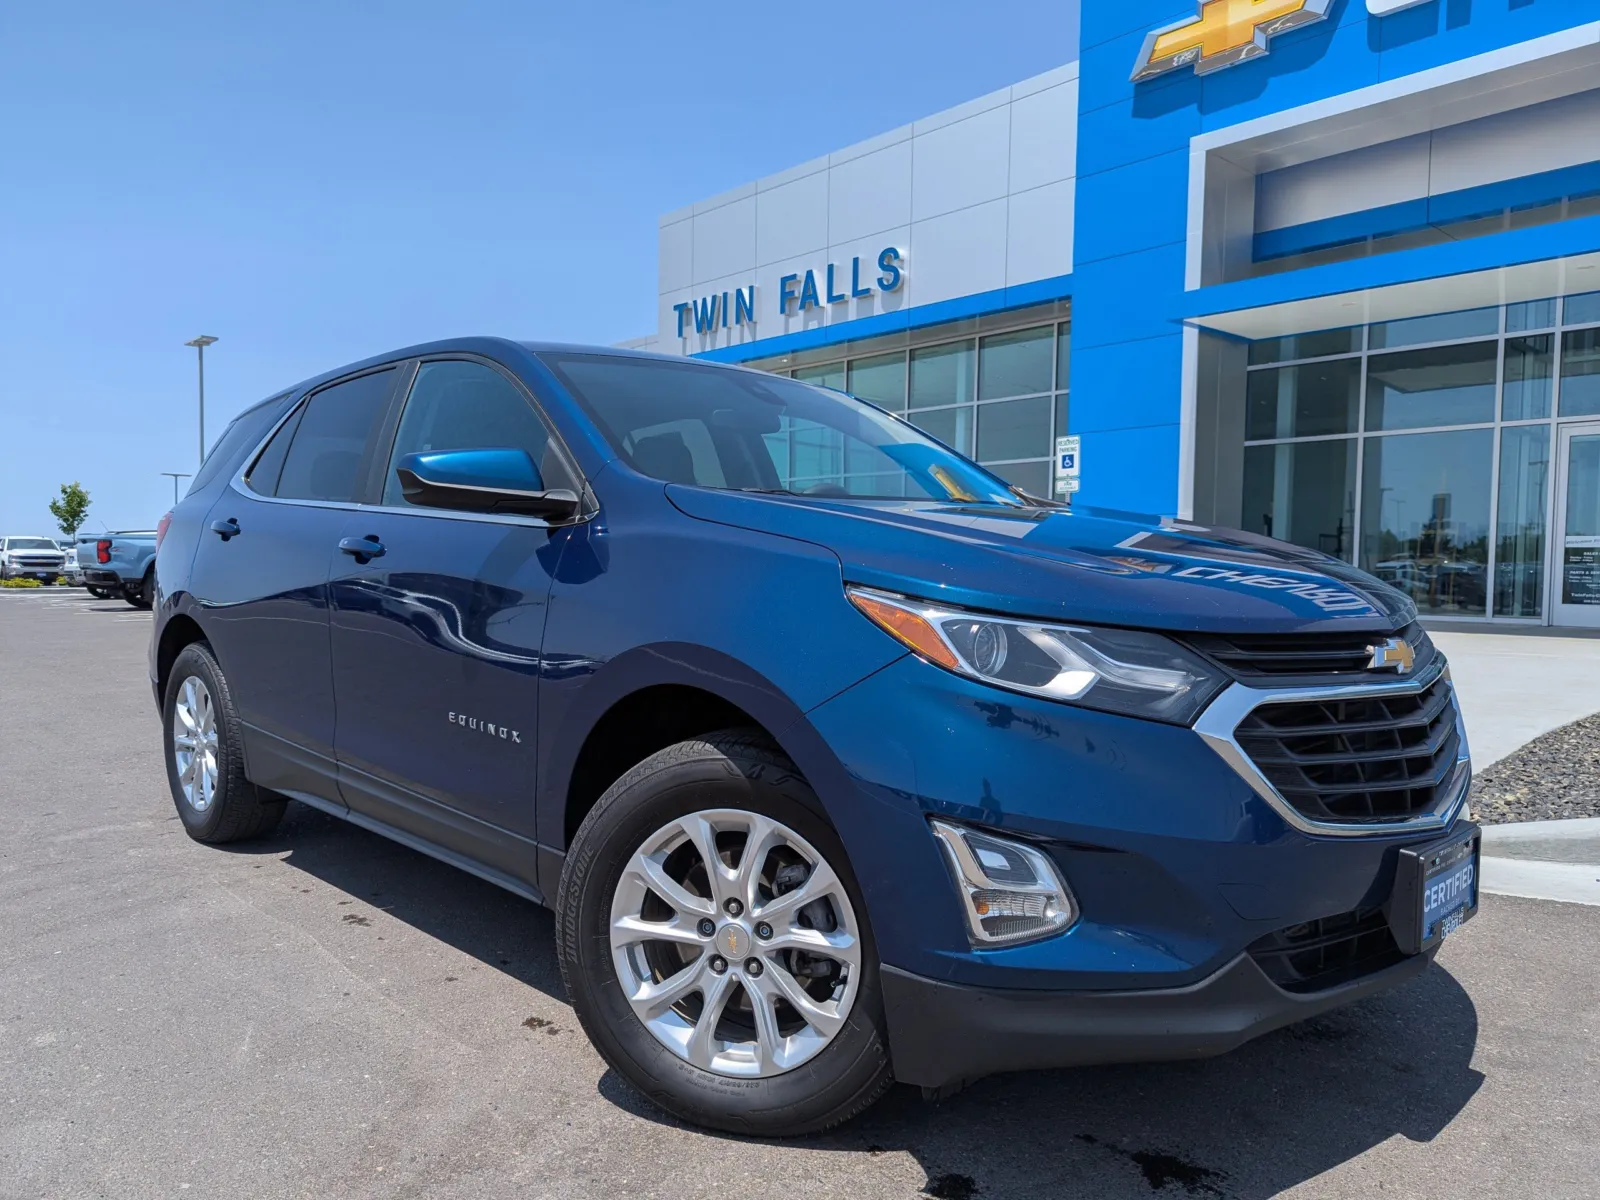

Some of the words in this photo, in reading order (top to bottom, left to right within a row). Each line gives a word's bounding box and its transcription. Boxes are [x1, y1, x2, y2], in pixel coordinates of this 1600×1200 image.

[673, 284, 755, 338] TWIN
[779, 247, 904, 315] FALLS
[448, 711, 521, 744] EQUINOX
[565, 841, 594, 964] BRIDGESTONE
[1424, 864, 1474, 912] CERTIFIED
